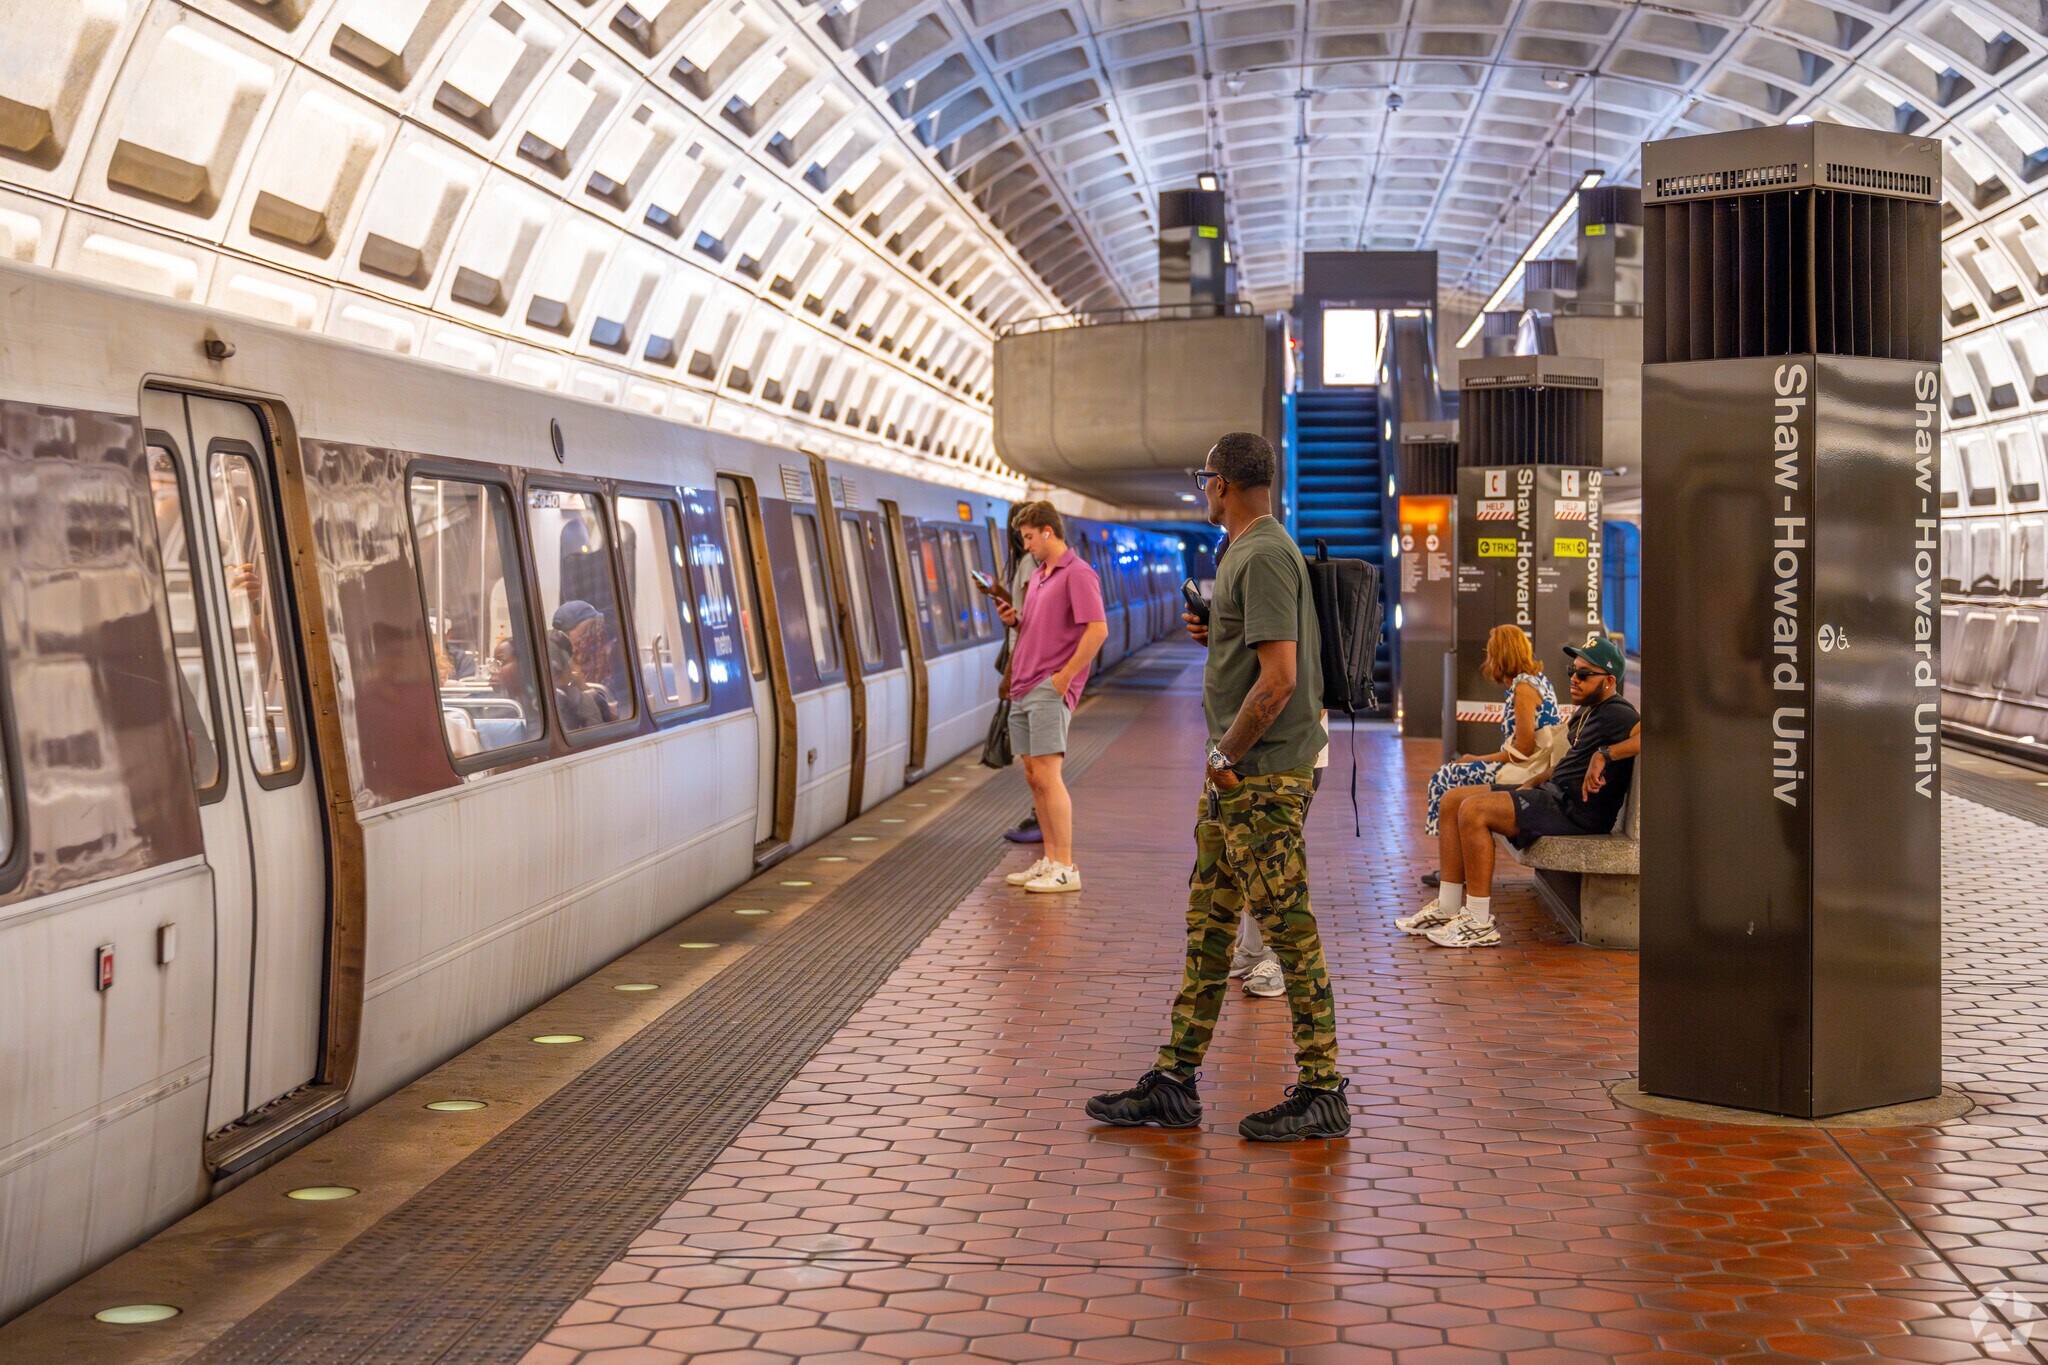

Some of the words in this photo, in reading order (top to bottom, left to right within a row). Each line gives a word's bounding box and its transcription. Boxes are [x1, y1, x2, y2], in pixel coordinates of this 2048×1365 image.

[1486, 502, 1505, 511] HELP
[1492, 542, 1516, 553] TRK2
[1517, 468, 1533, 625] Shaw-Howard
[1556, 542, 1576, 553] TRK1
[1562, 502, 1579, 511] HELP
[1587, 470, 1602, 625] Shaw-Howard
[1773, 363, 1808, 691] Shaw-Howard
[1915, 370, 1937, 688] Shaw-Howard
[1484, 704, 1502, 713] HELP
[1914, 703, 1937, 799] Univ
[1772, 707, 1805, 807] Univ
